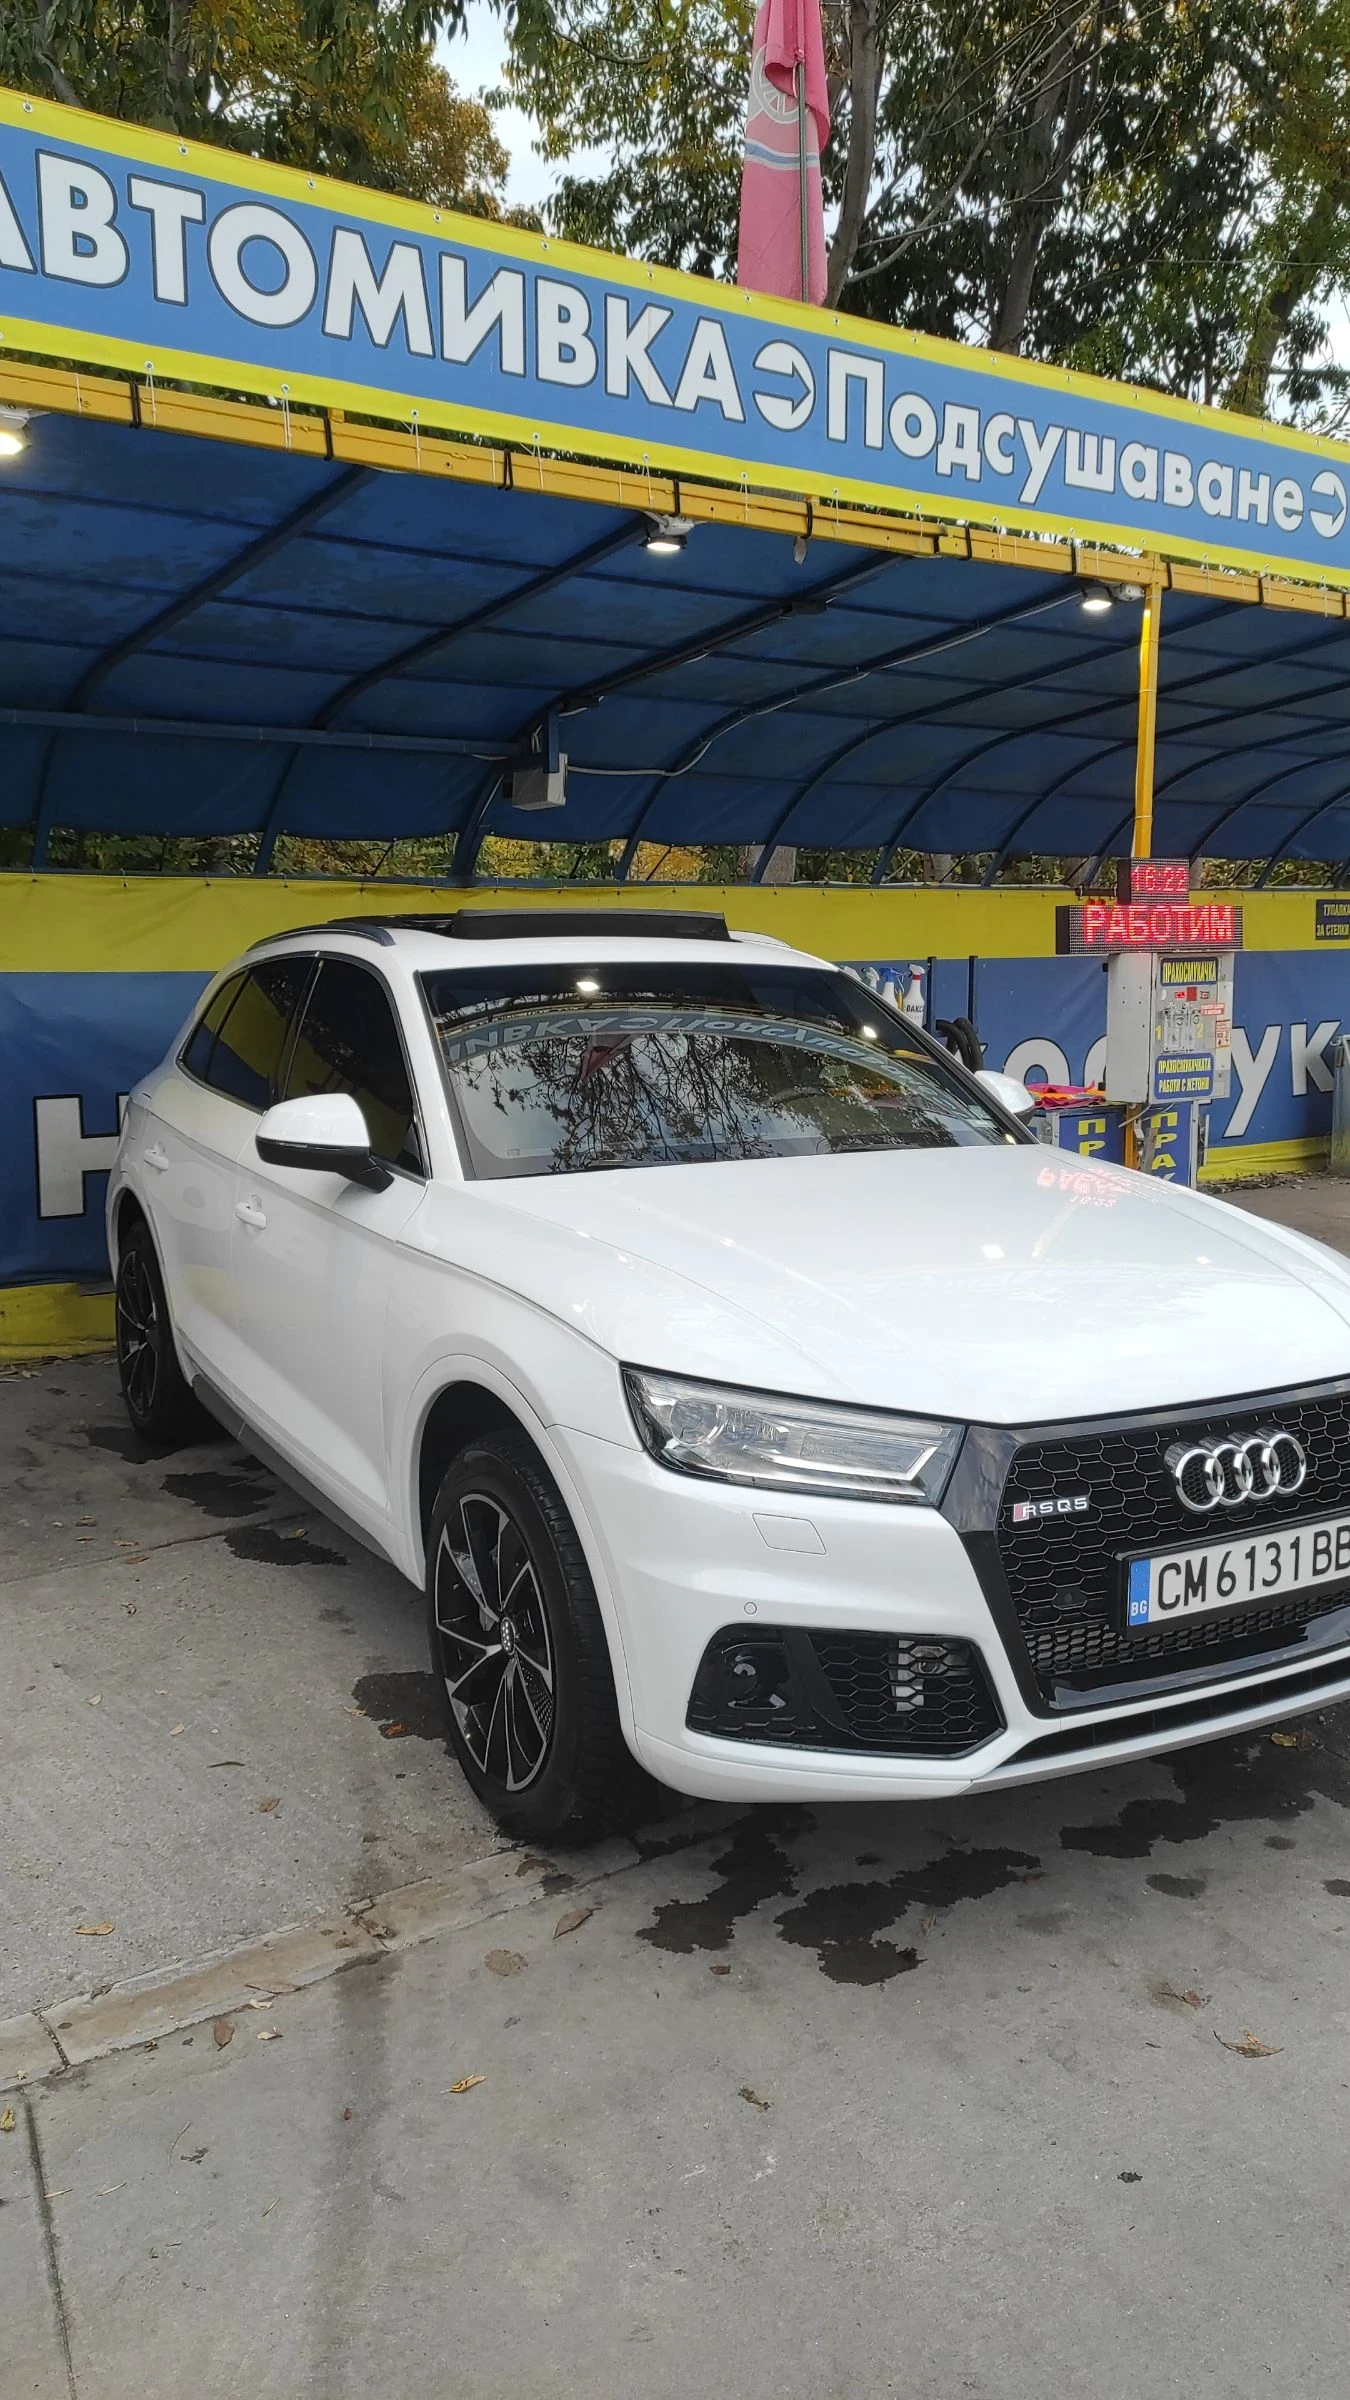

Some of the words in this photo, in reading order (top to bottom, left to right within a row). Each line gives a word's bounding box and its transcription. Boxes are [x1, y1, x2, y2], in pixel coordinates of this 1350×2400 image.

[826, 346, 1305, 533] Подсушаване
[1131, 866, 1188, 892] 16:22
[1085, 904, 1234, 943] РАБОТИМ
[1163, 960, 1217, 983] ПРАХОСМУКАЧКА
[1023, 1497, 1087, 1518] RSQ5
[1131, 1600, 1148, 1616] BG
